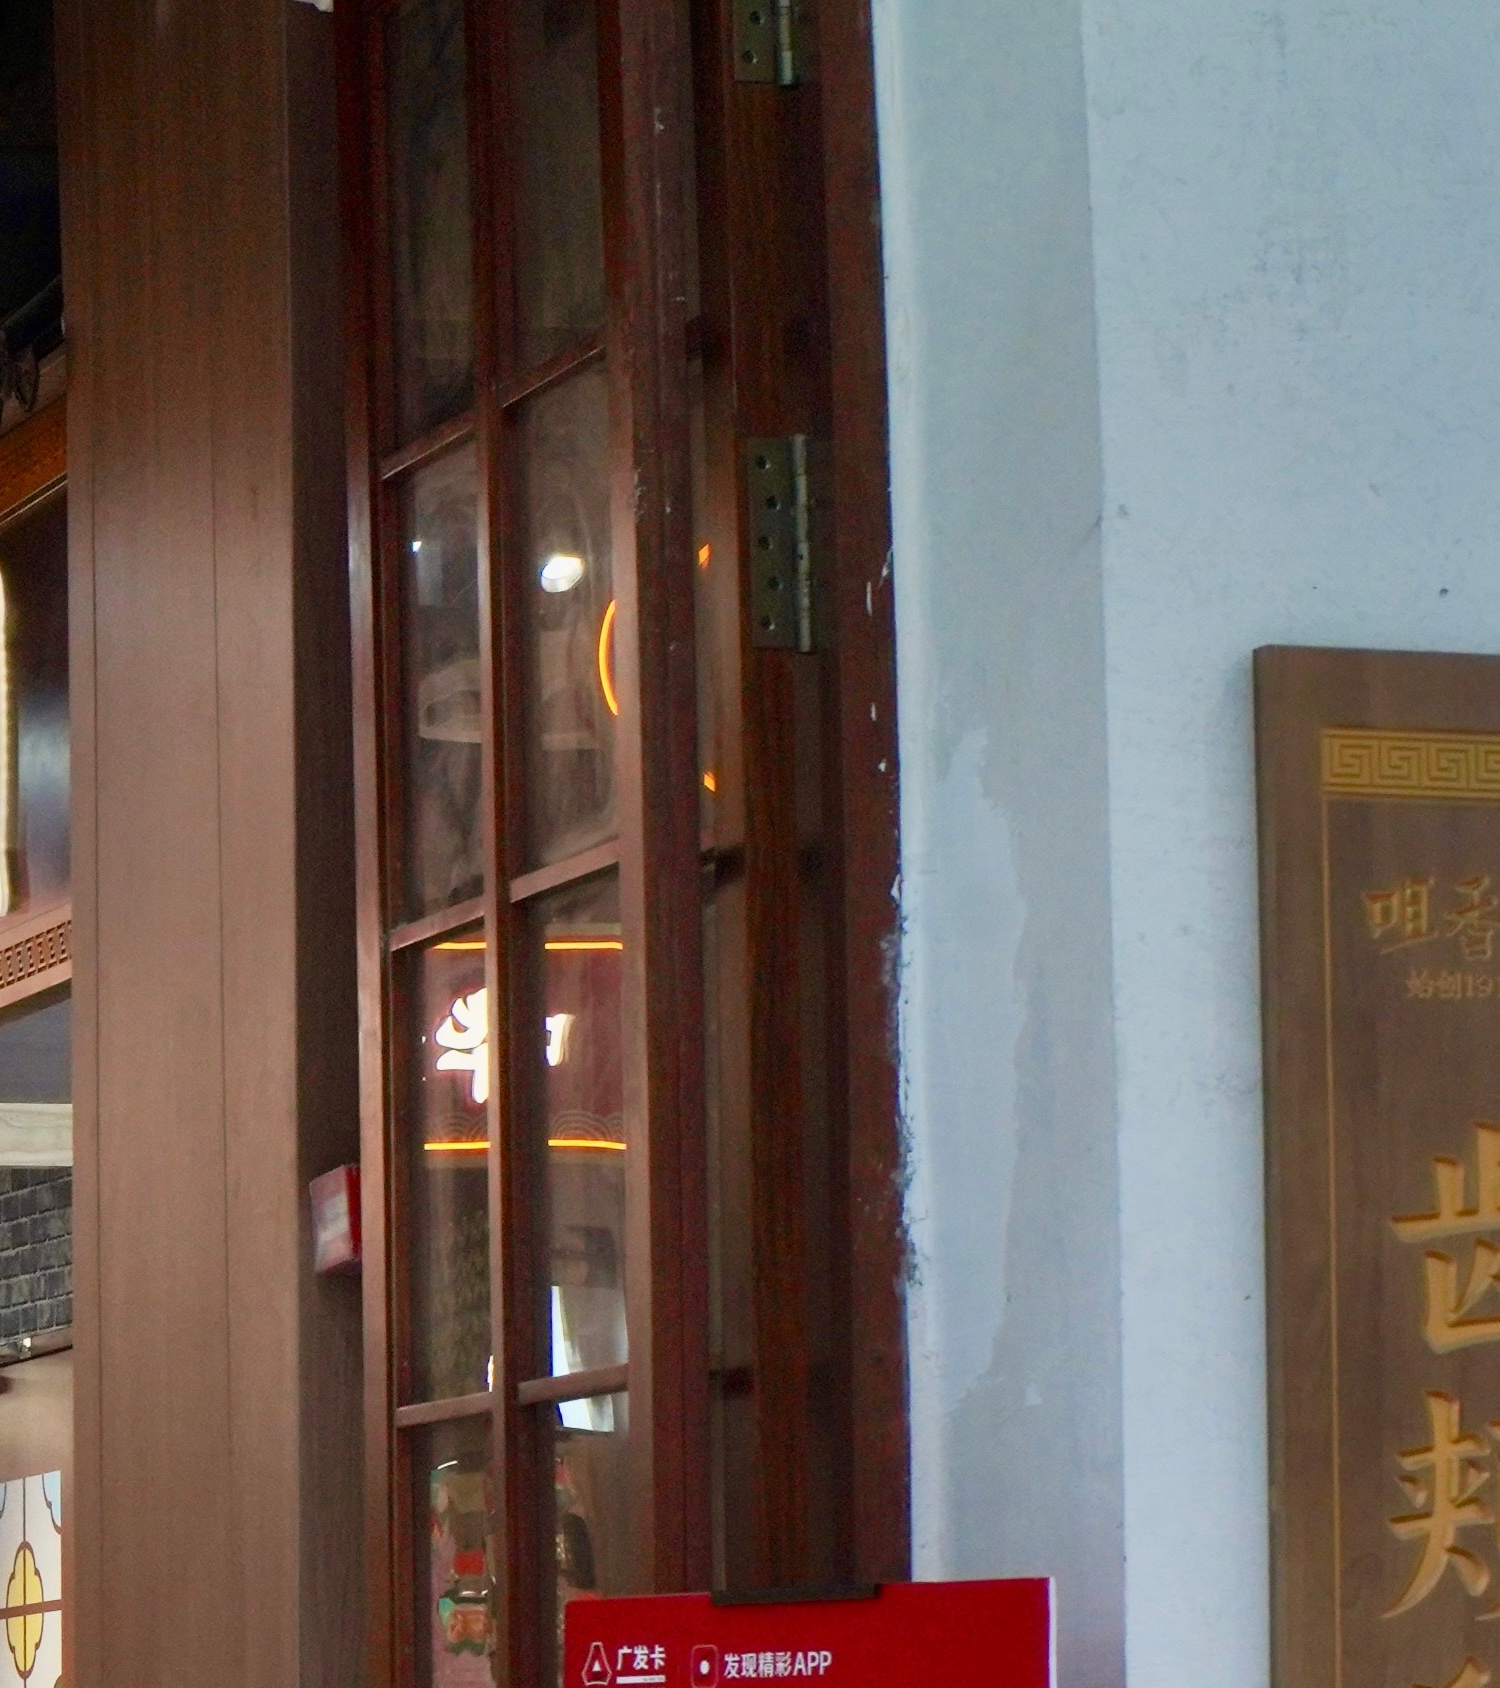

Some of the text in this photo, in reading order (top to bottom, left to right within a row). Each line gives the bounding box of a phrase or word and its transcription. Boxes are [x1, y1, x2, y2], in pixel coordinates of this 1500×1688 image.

[616, 1645, 666, 1671] 广发卡
[724, 1651, 832, 1678] 发现精彩APP
